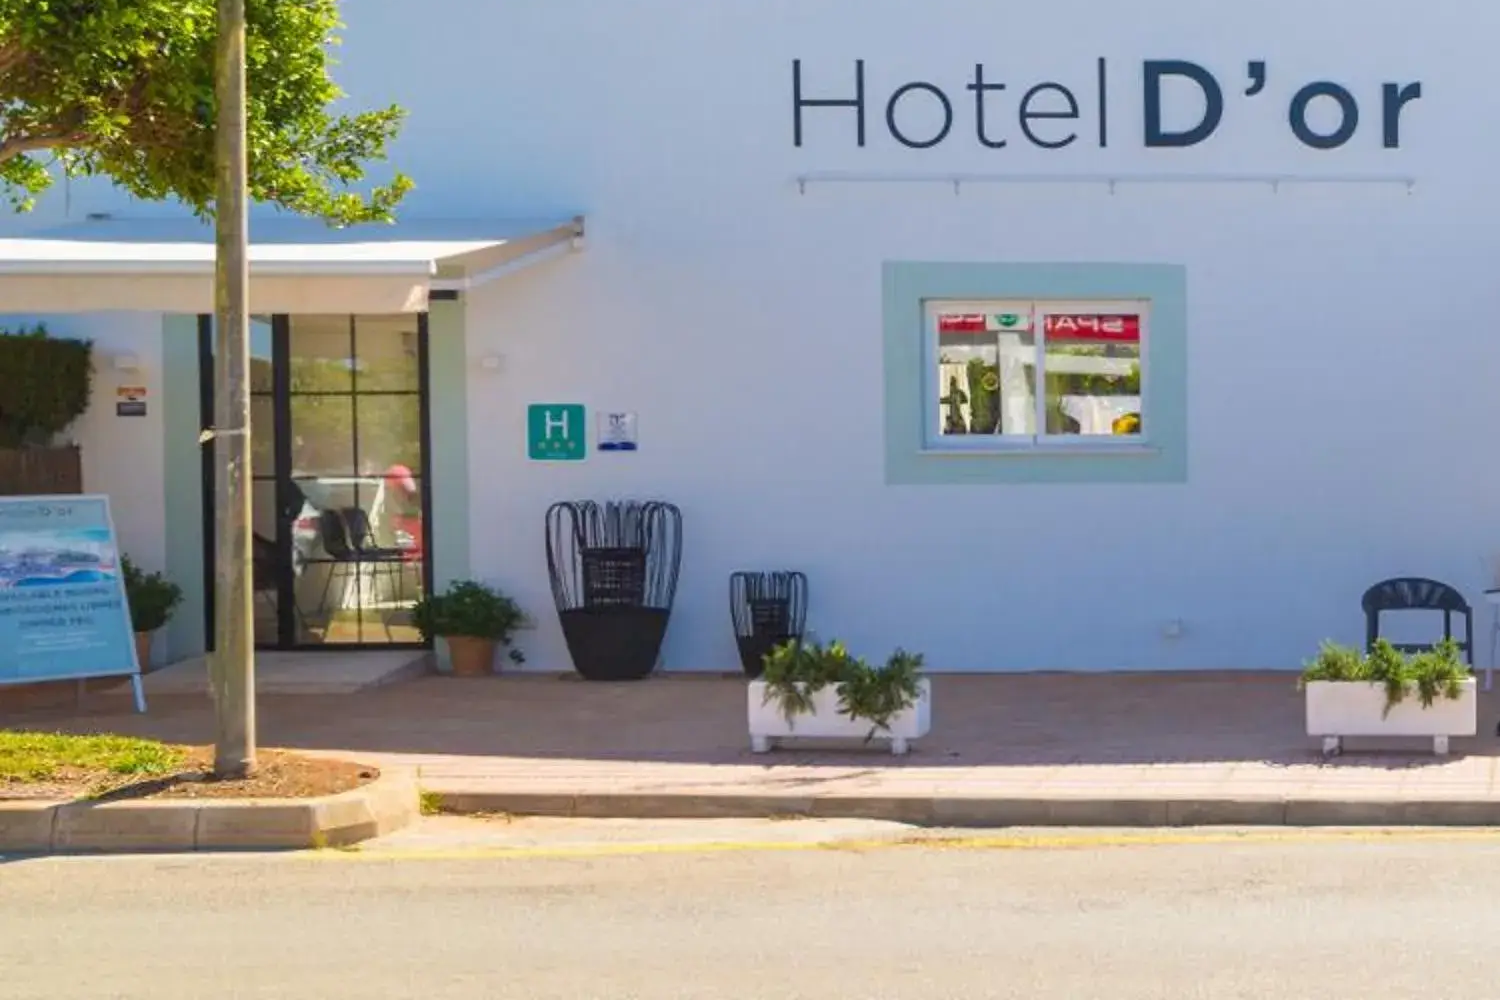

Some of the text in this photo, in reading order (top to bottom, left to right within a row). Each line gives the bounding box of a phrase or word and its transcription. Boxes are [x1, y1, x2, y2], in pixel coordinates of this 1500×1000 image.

[793, 57, 1421, 149] Hotel D'or
[544, 409, 569, 440] H
